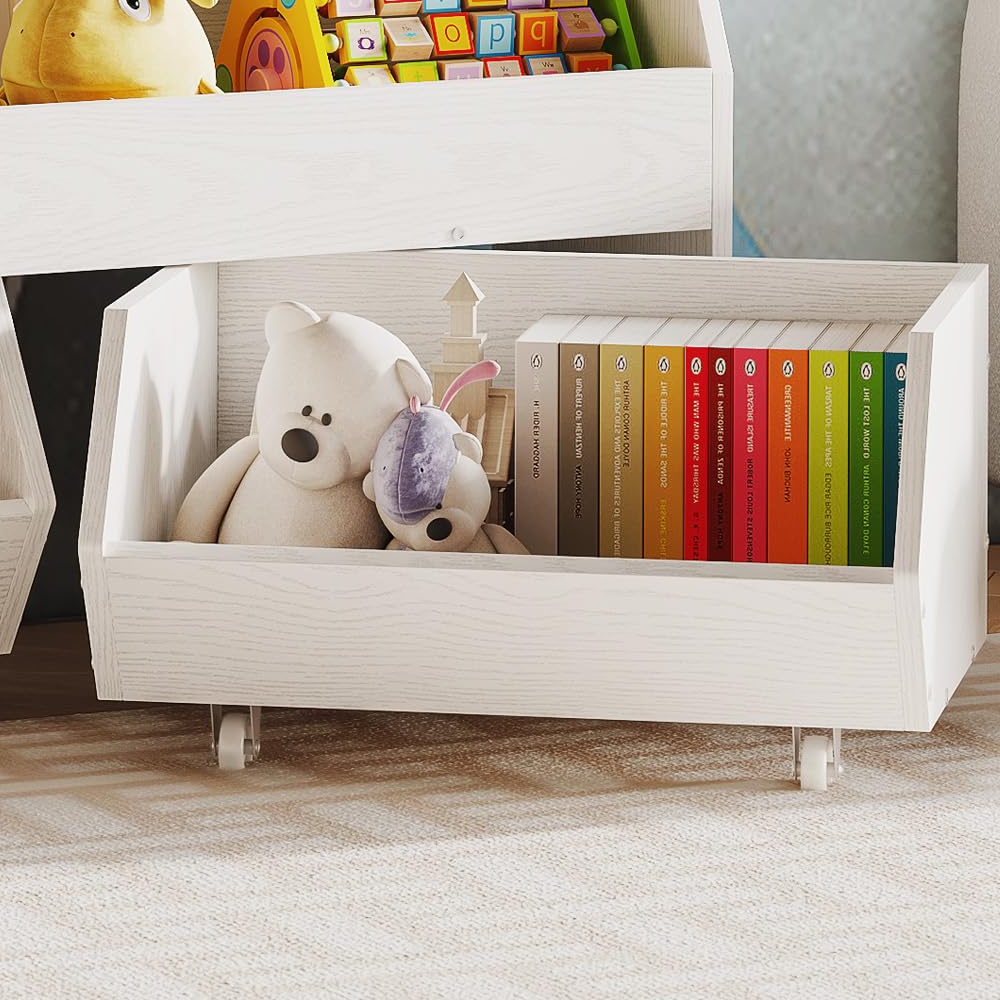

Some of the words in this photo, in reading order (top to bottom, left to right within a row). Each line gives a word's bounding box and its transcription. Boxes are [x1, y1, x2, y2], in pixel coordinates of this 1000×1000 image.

[445, 24, 460, 42] o
[490, 23, 505, 50] p
[531, 20, 546, 47] q
